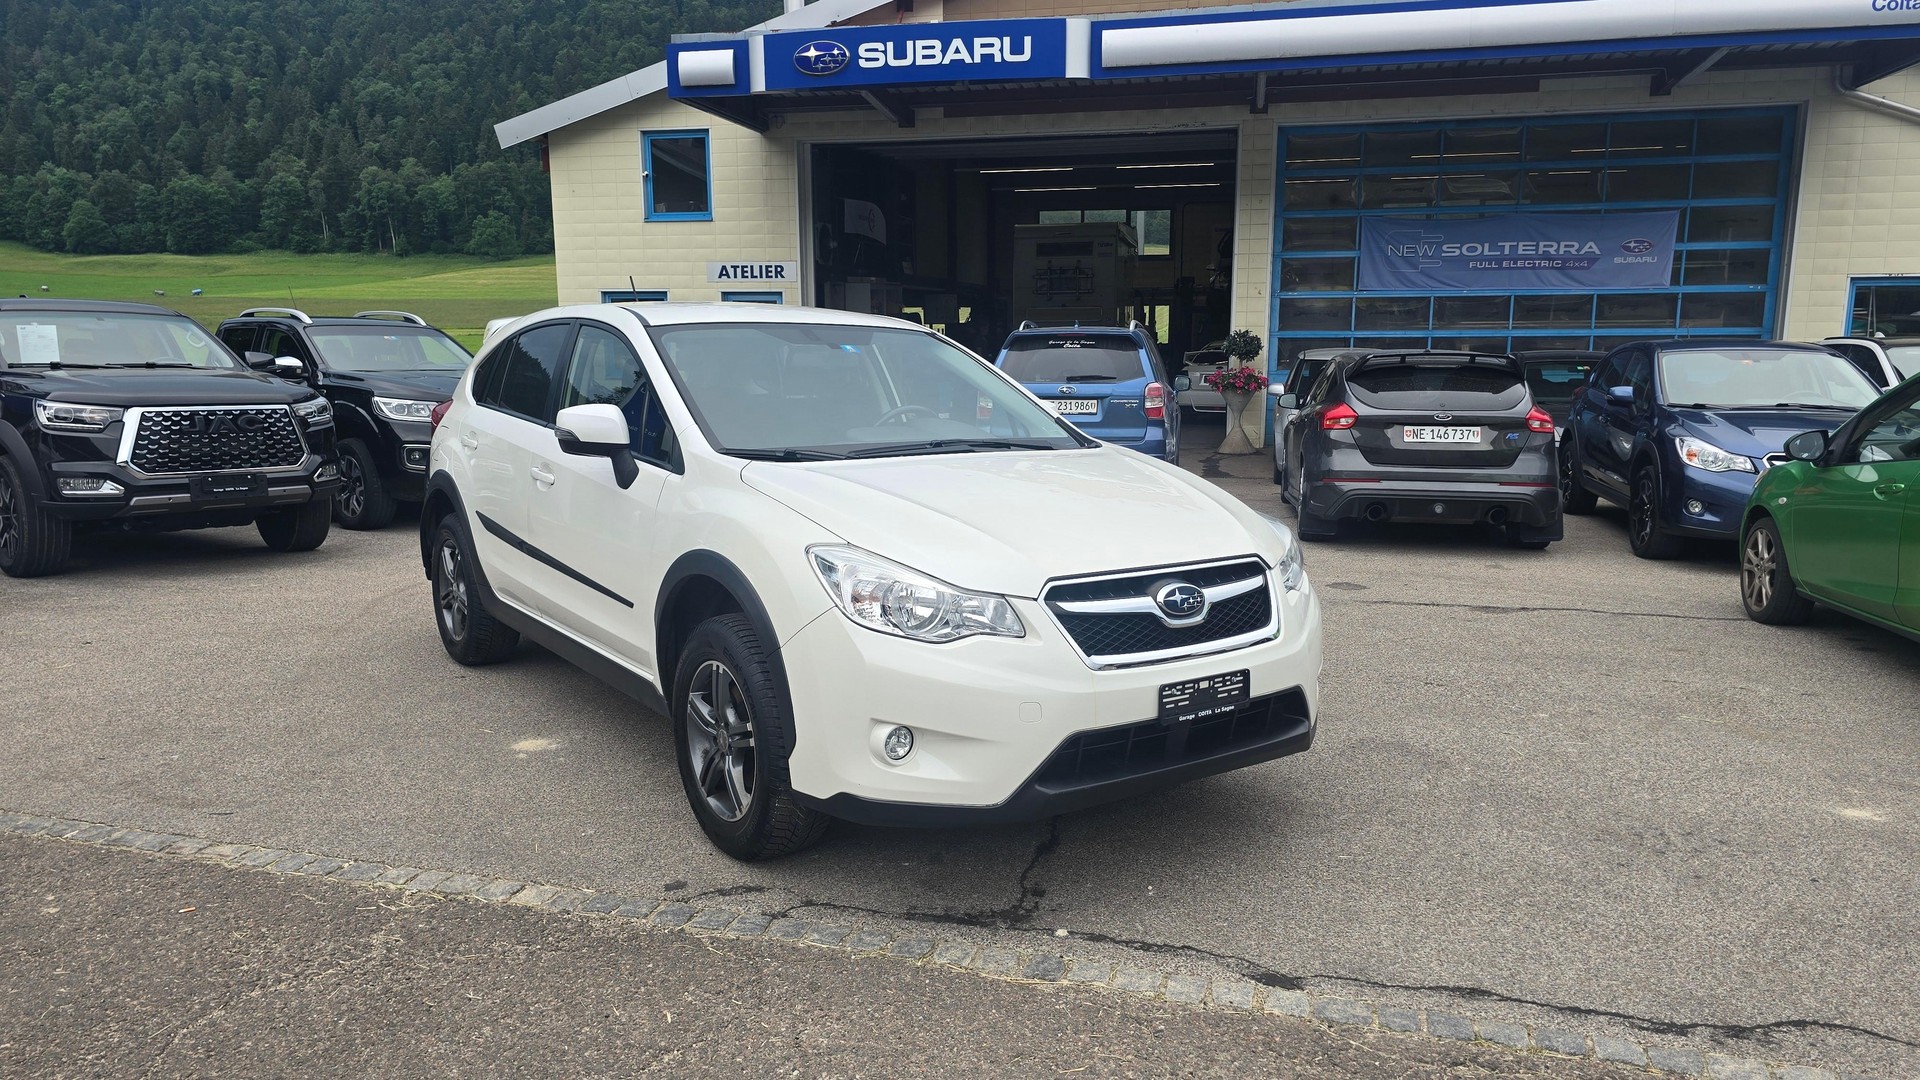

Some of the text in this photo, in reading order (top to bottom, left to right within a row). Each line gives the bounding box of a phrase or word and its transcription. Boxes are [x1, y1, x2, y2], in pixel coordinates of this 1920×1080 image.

[858, 35, 1032, 69] SUBARU
[1388, 241, 1602, 257] NEW SOLTERRA
[1469, 259, 1588, 269] FULL ELECTRIC 4x4
[1613, 255, 1658, 264] SUBARU
[718, 265, 785, 279] ATELIER
[181, 415, 264, 433] JAC
